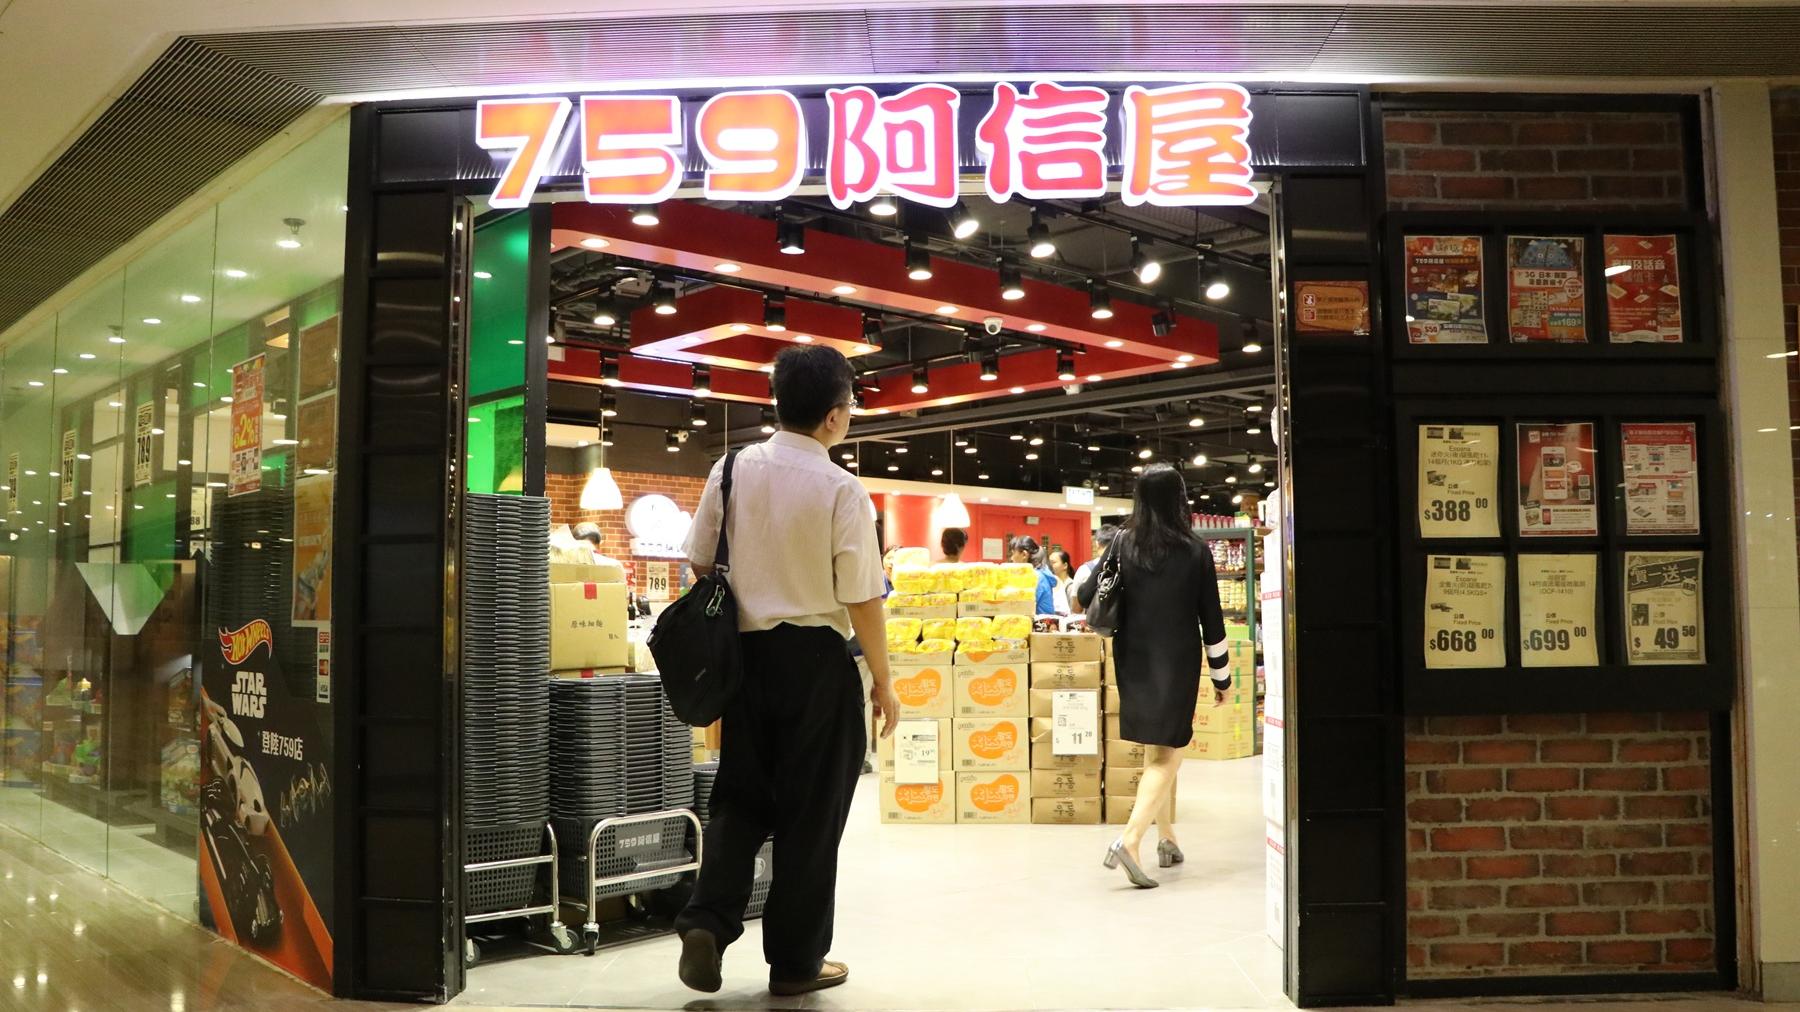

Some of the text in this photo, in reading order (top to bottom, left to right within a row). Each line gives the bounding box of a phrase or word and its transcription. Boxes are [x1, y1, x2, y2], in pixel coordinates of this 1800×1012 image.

[475, 82, 1259, 207] 759阿信屋
[1475, 498, 1488, 508] 00
[649, 577, 667, 591] 789
[1481, 629, 1494, 639] 00
[1574, 627, 1587, 637] 00
[1655, 627, 1679, 649] 49
[1682, 625, 1696, 637] 50
[231, 671, 267, 696] STAR
[231, 693, 267, 719] WARS
[262, 730, 304, 761] 登陸759店
